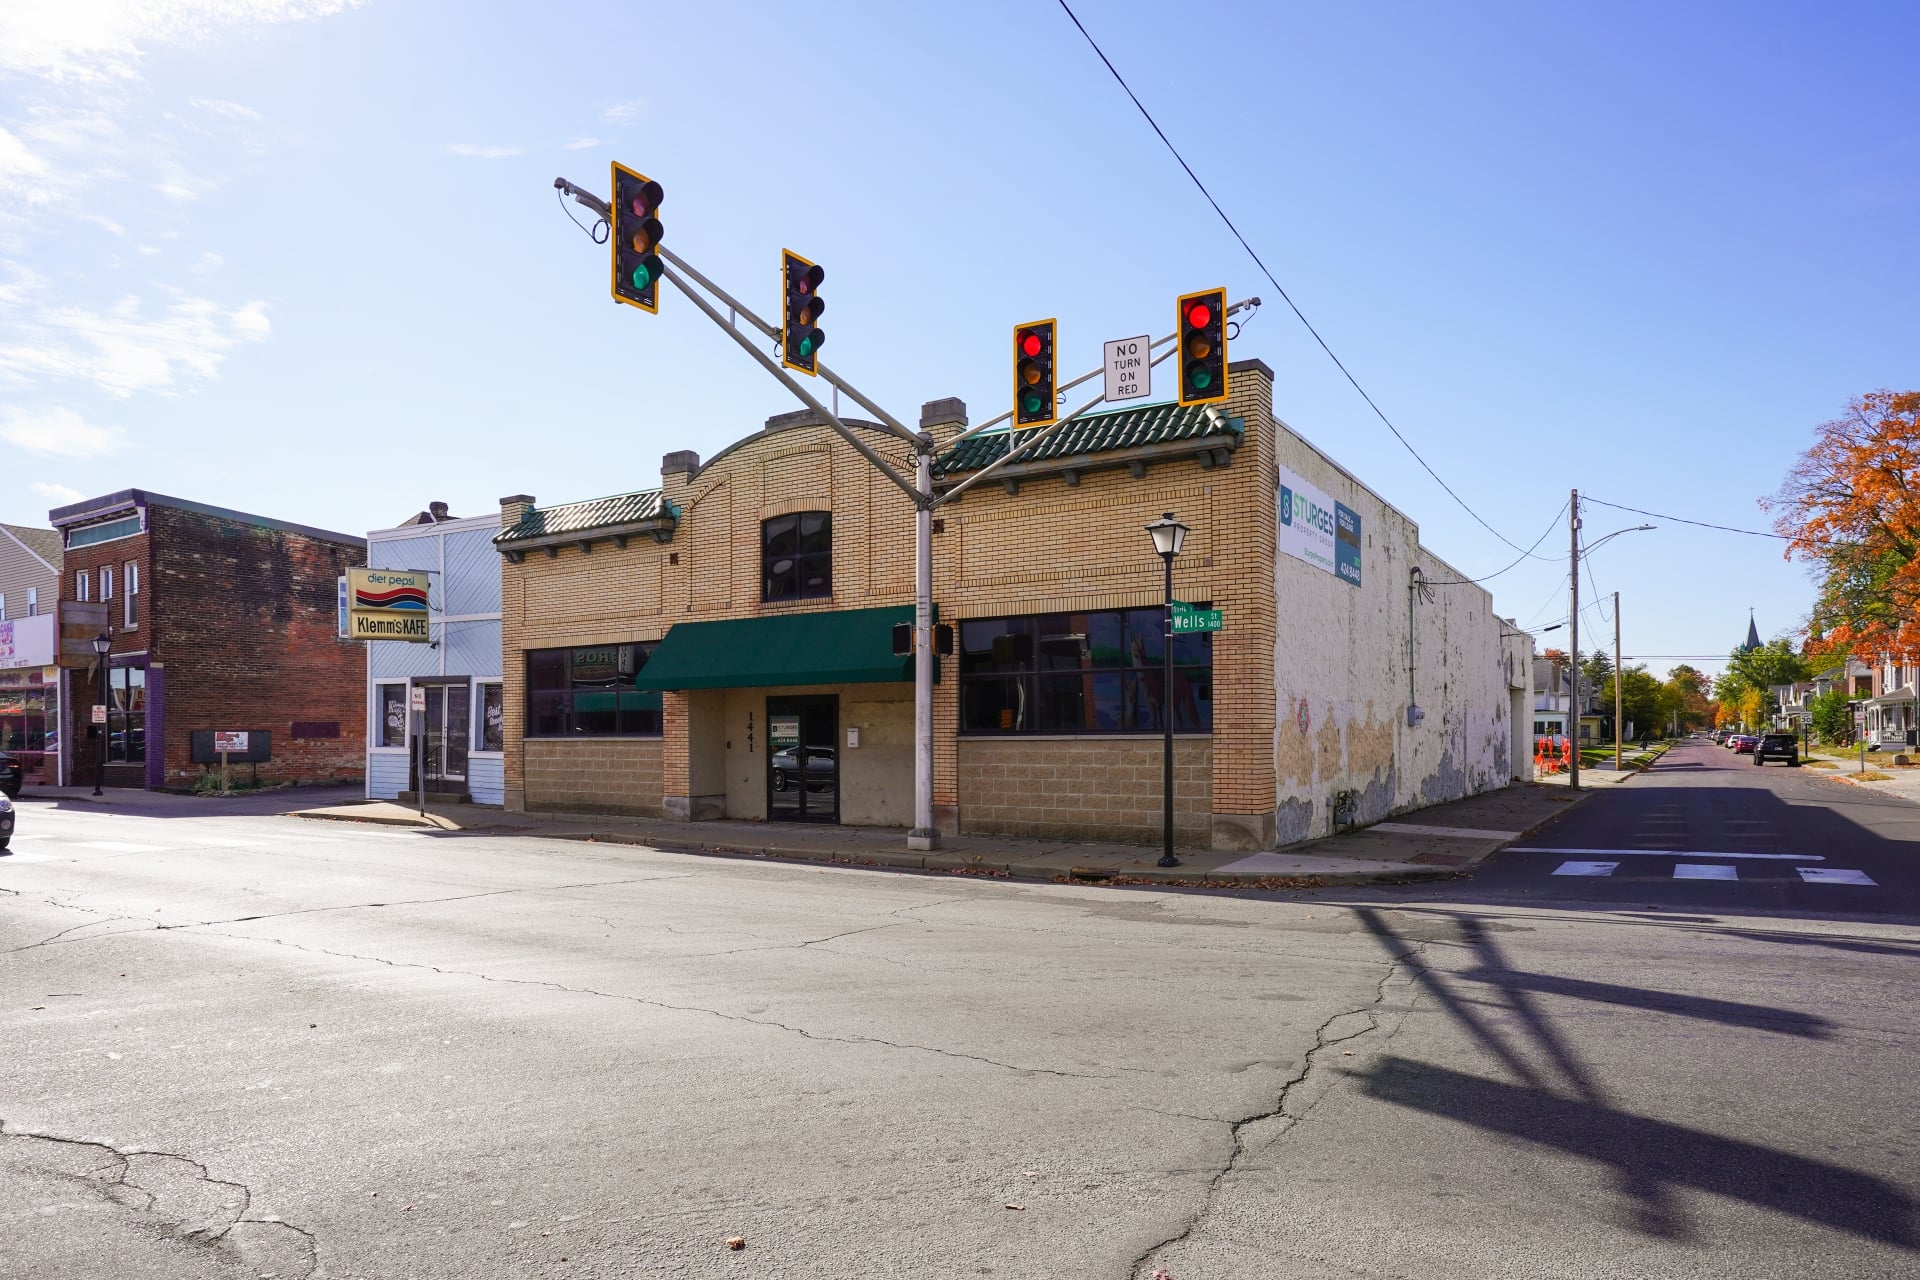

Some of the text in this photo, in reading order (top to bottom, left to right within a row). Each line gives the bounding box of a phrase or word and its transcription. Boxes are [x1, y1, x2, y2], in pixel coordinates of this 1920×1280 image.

[1117, 343, 1138, 357] NO
[1113, 357, 1141, 371] TURN
[1120, 371, 1135, 382] ON
[1118, 384, 1138, 395] RED
[1293, 491, 1334, 537] STURGES
[1293, 521, 1318, 540] PROPERTY
[368, 572, 415, 586] diet pepsi
[357, 616, 427, 635] Klemm's KAFE
[1174, 615, 1204, 628] Wells
[1207, 620, 1221, 628] 1400
[746, 711, 754, 753] 1441
